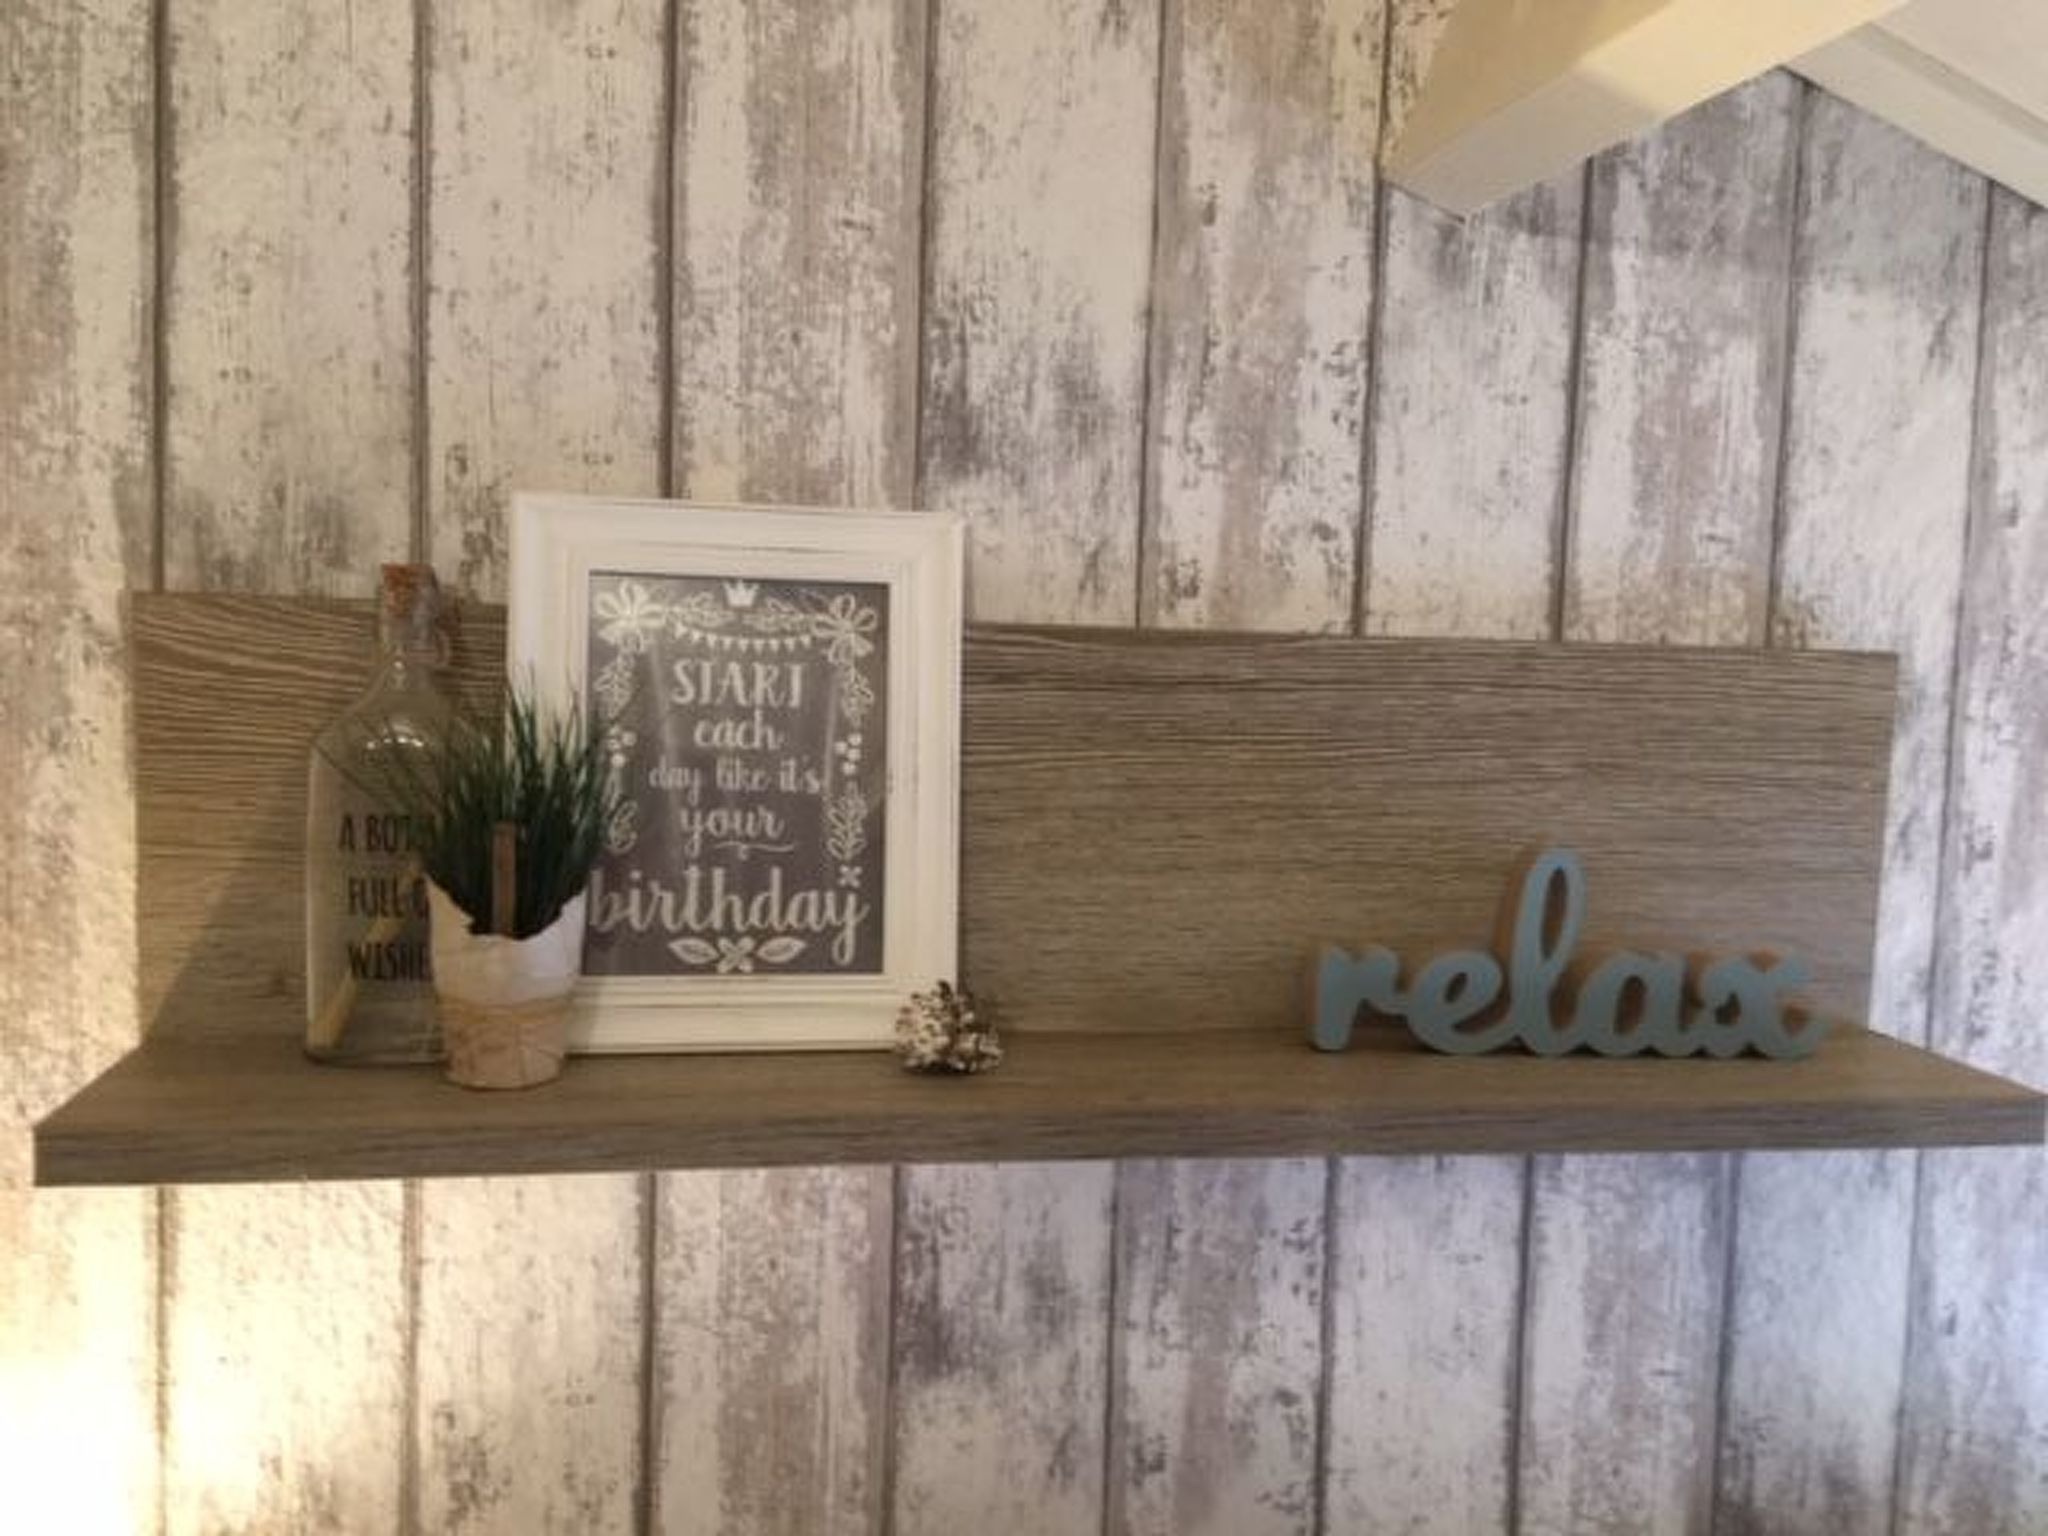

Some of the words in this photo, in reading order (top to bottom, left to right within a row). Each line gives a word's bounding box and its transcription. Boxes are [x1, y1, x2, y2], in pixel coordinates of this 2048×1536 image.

[672, 659, 804, 707] START
[693, 708, 784, 750] each
[649, 755, 702, 806] day
[716, 756, 771, 792] like
[779, 757, 821, 795] it's
[338, 815, 355, 850] A
[680, 804, 785, 858] your
[349, 876, 406, 918] FULL
[589, 864, 870, 965] birthday
[1307, 846, 1831, 1058] relax
